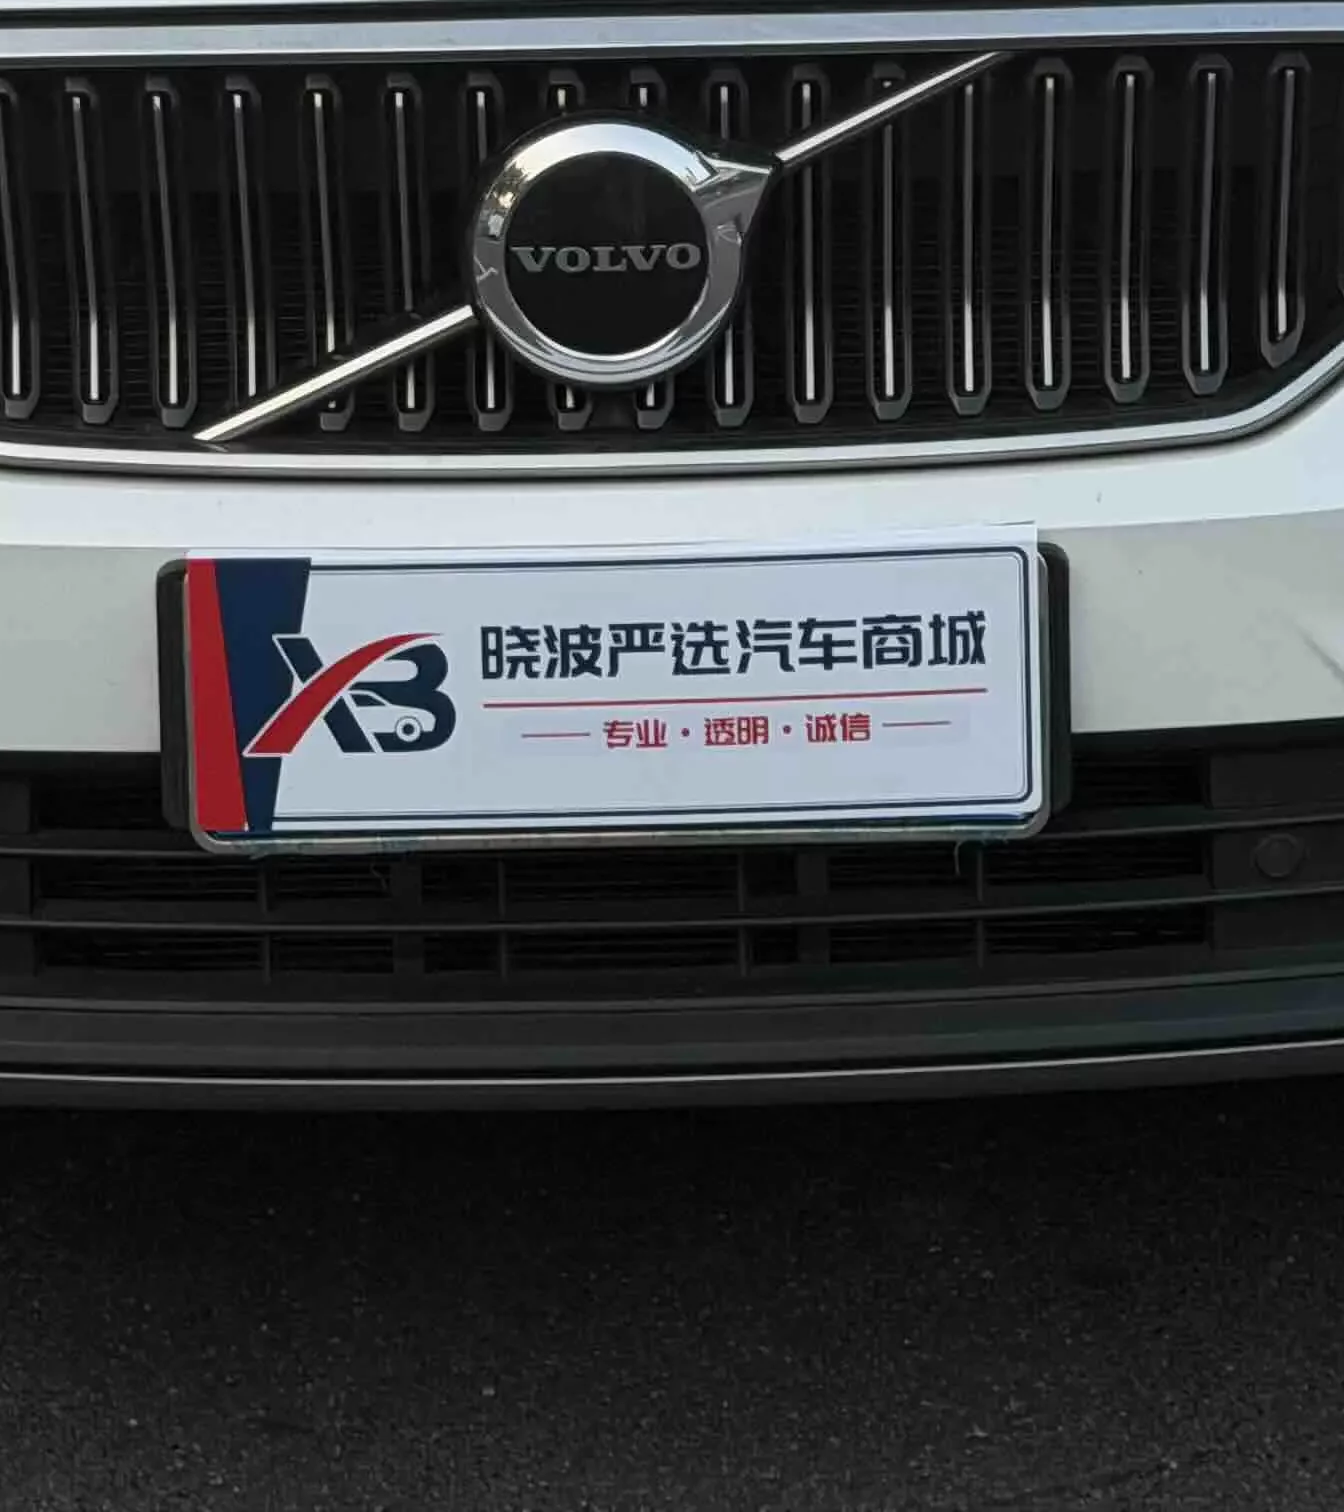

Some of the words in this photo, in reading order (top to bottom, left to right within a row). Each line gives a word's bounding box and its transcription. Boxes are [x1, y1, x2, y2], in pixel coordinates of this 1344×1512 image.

[509, 242, 702, 273] VOLVO
[479, 610, 988, 680] 晓波严选汽车商城
